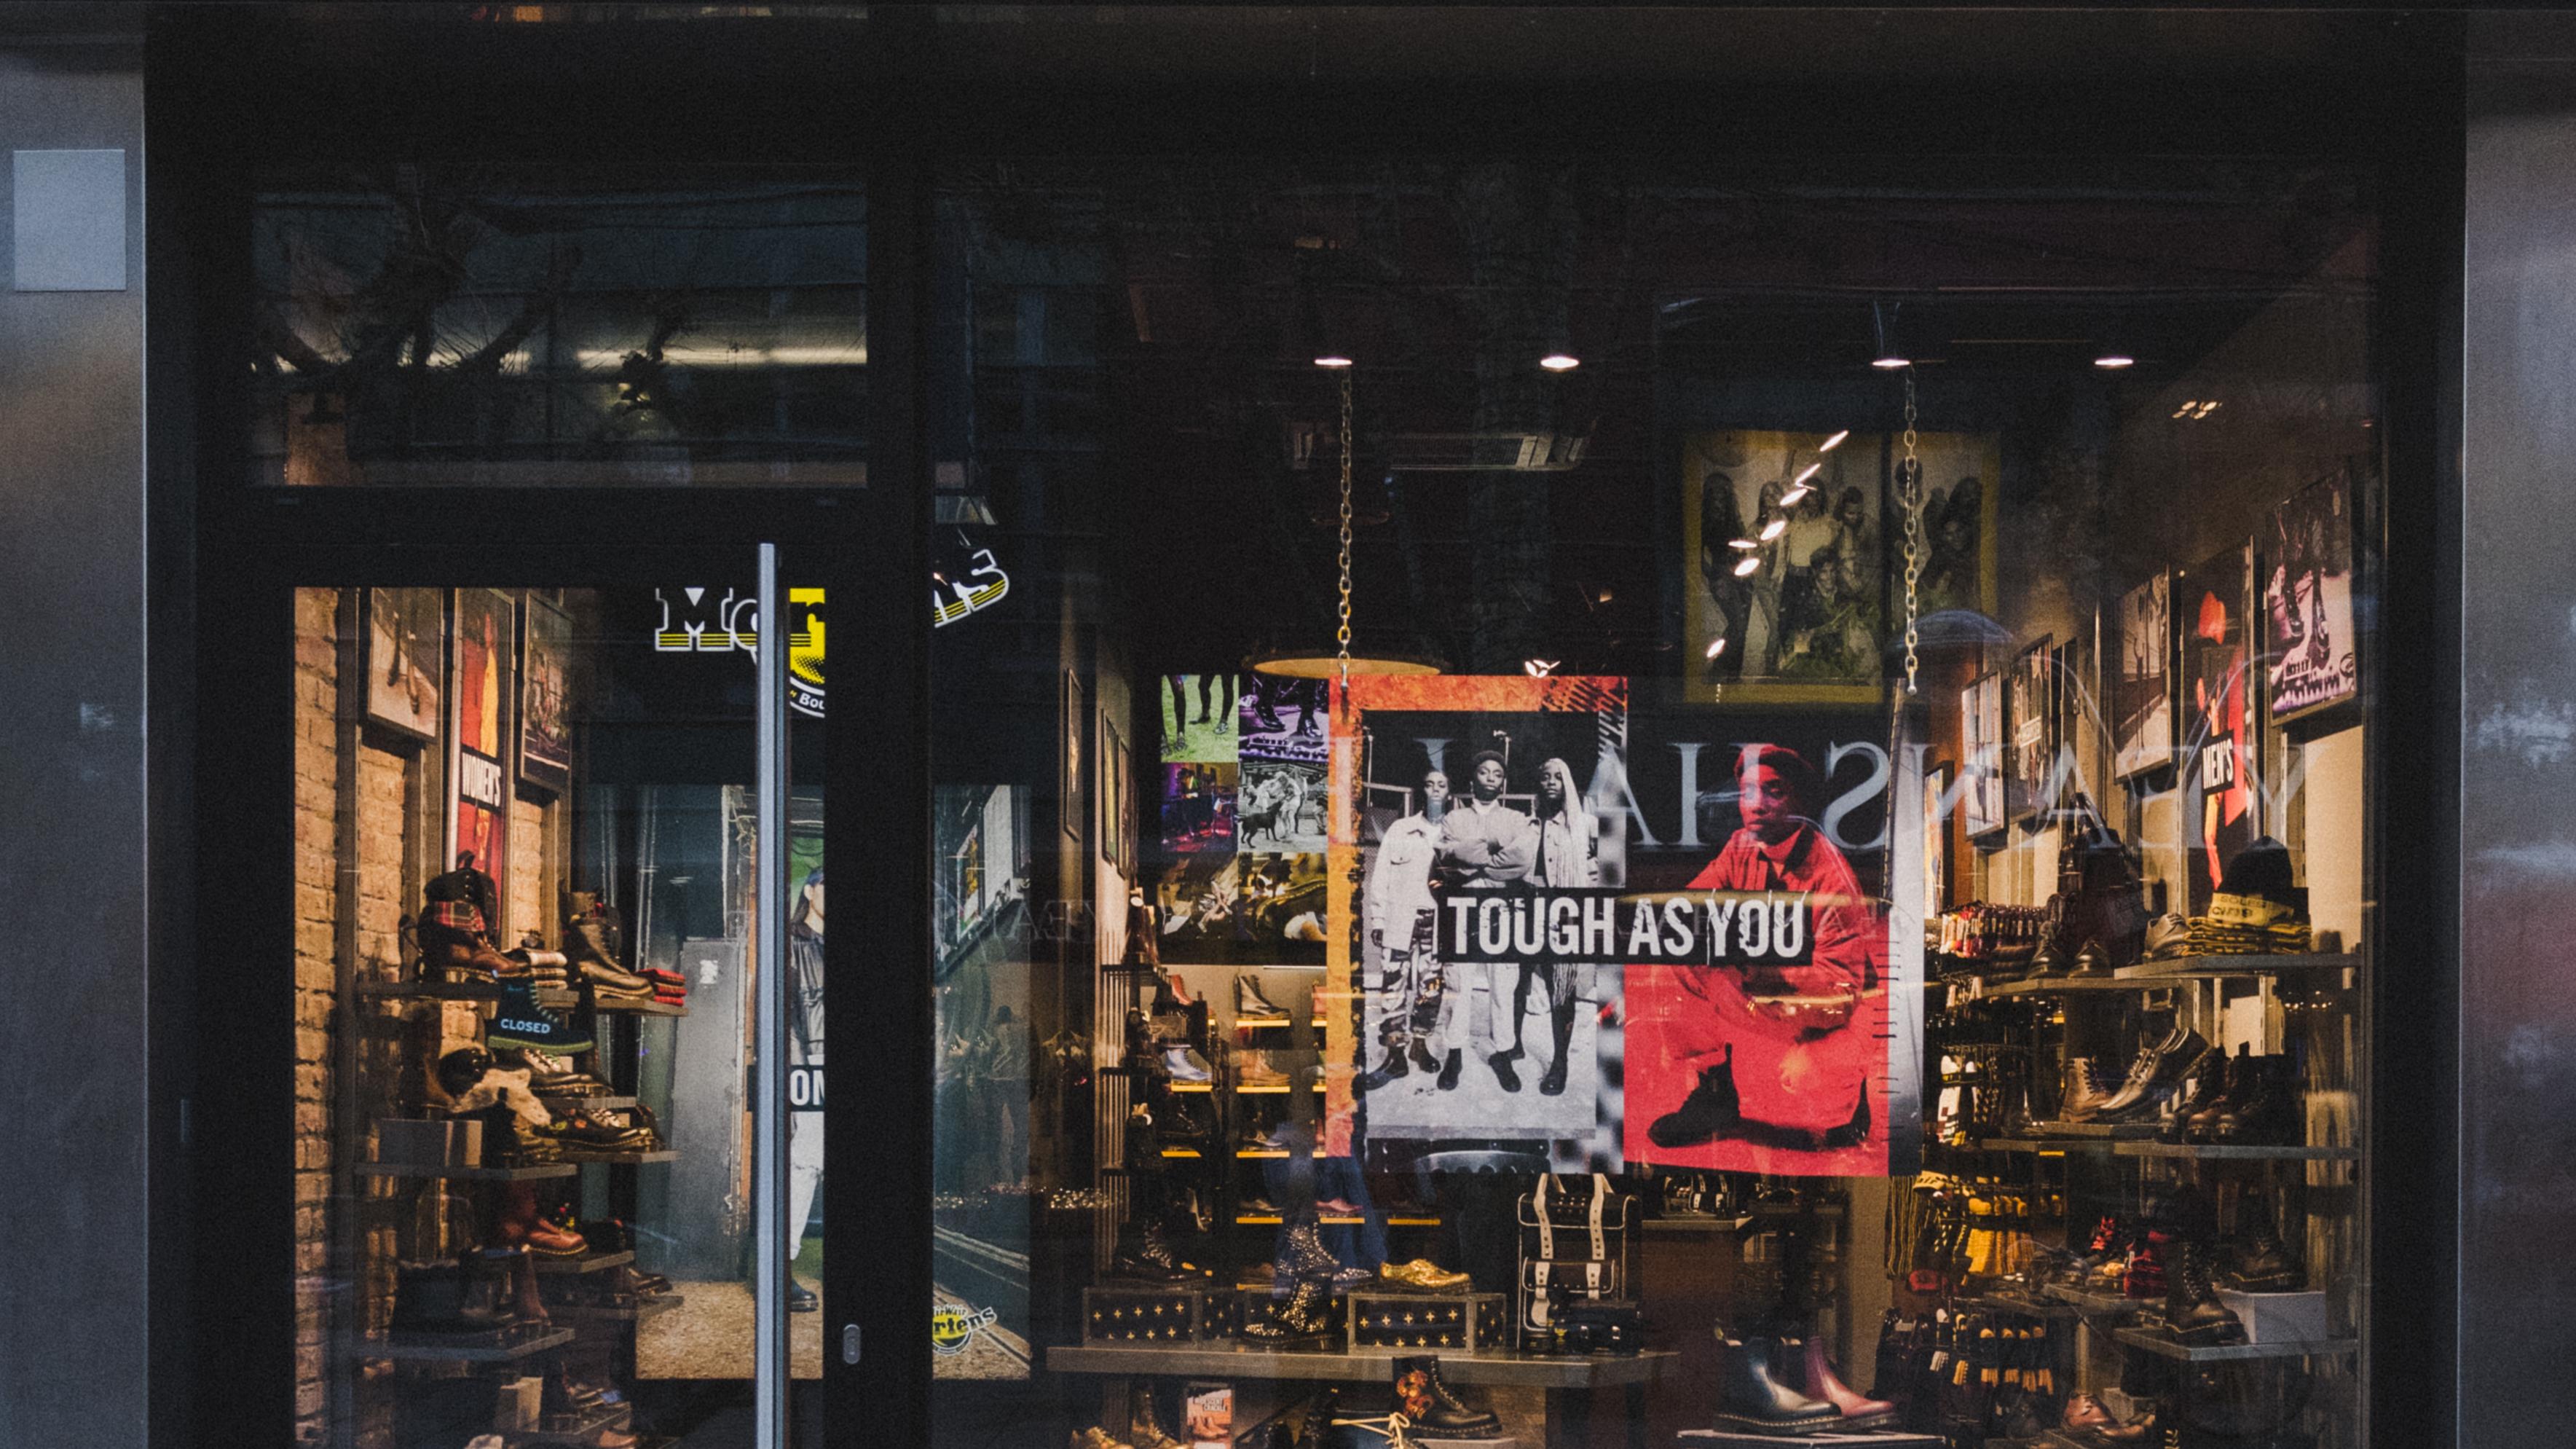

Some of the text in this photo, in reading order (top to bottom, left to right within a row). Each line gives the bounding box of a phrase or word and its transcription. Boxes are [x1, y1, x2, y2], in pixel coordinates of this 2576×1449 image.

[2202, 737, 2234, 790] MEN'S
[1446, 896, 1615, 956] TOUGH
[1628, 897, 1695, 957] AS
[1706, 897, 1805, 958] YOU
[500, 1018, 551, 1034] CLOSED
[933, 1307, 997, 1335] rtens
